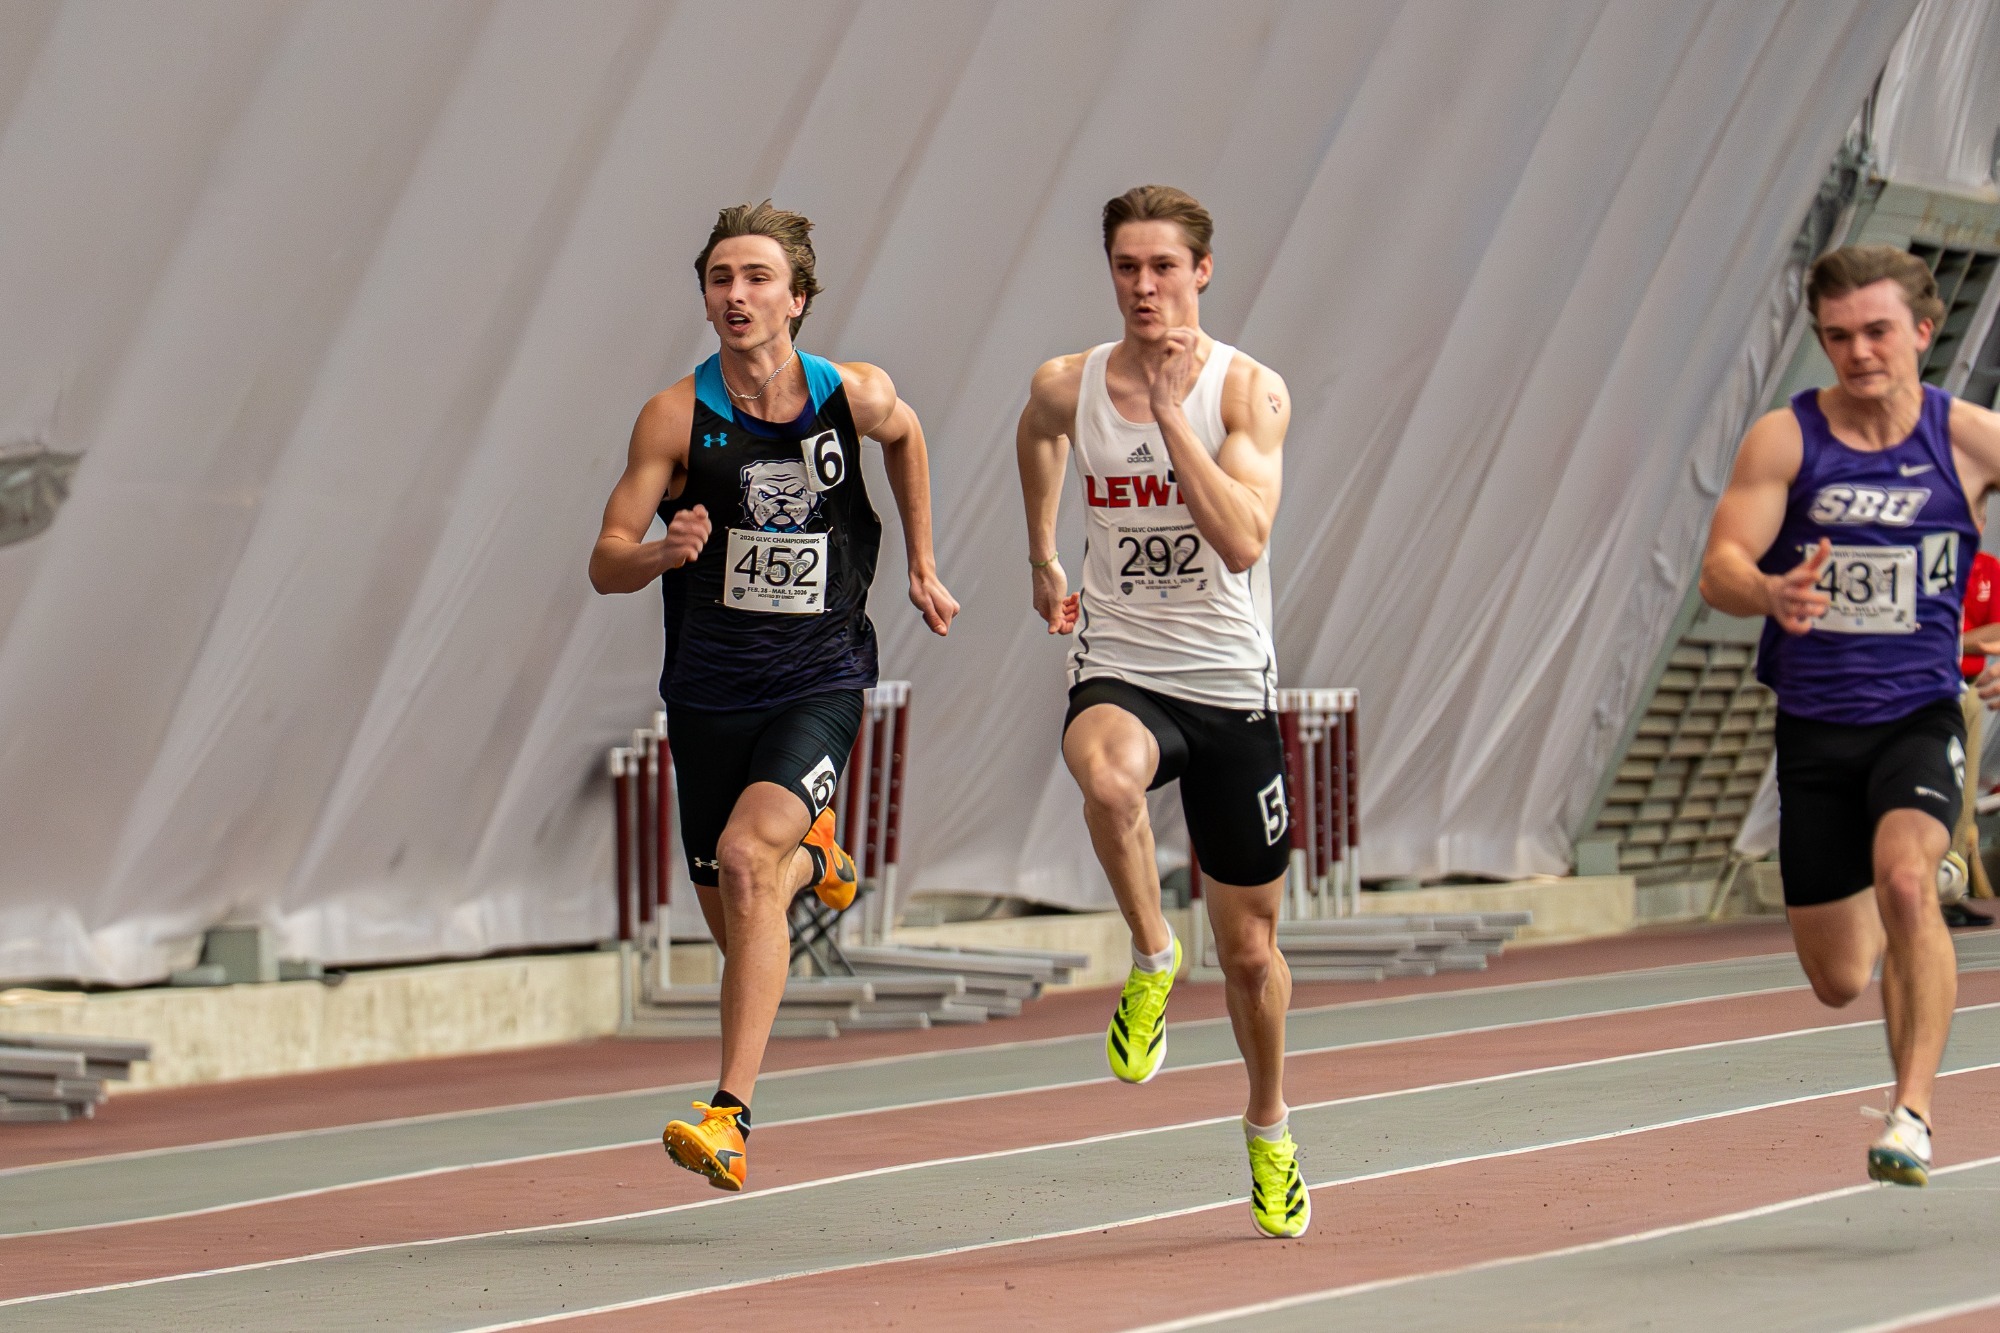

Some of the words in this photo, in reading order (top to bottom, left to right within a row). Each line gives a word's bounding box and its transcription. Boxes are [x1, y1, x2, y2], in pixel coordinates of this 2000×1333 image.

[814, 431, 843, 487] 6
[1127, 455, 1154, 463] adidas
[1809, 484, 1931, 526] SBU
[740, 534, 755, 542] 2026
[772, 537, 820, 545] CHAMPIONSHIPS
[1118, 533, 1204, 577] 292
[734, 544, 819, 587] 452
[1815, 561, 1898, 604] 431
[1929, 537, 1955, 592] 4
[811, 770, 836, 810] 6
[1264, 785, 1284, 841] 5
